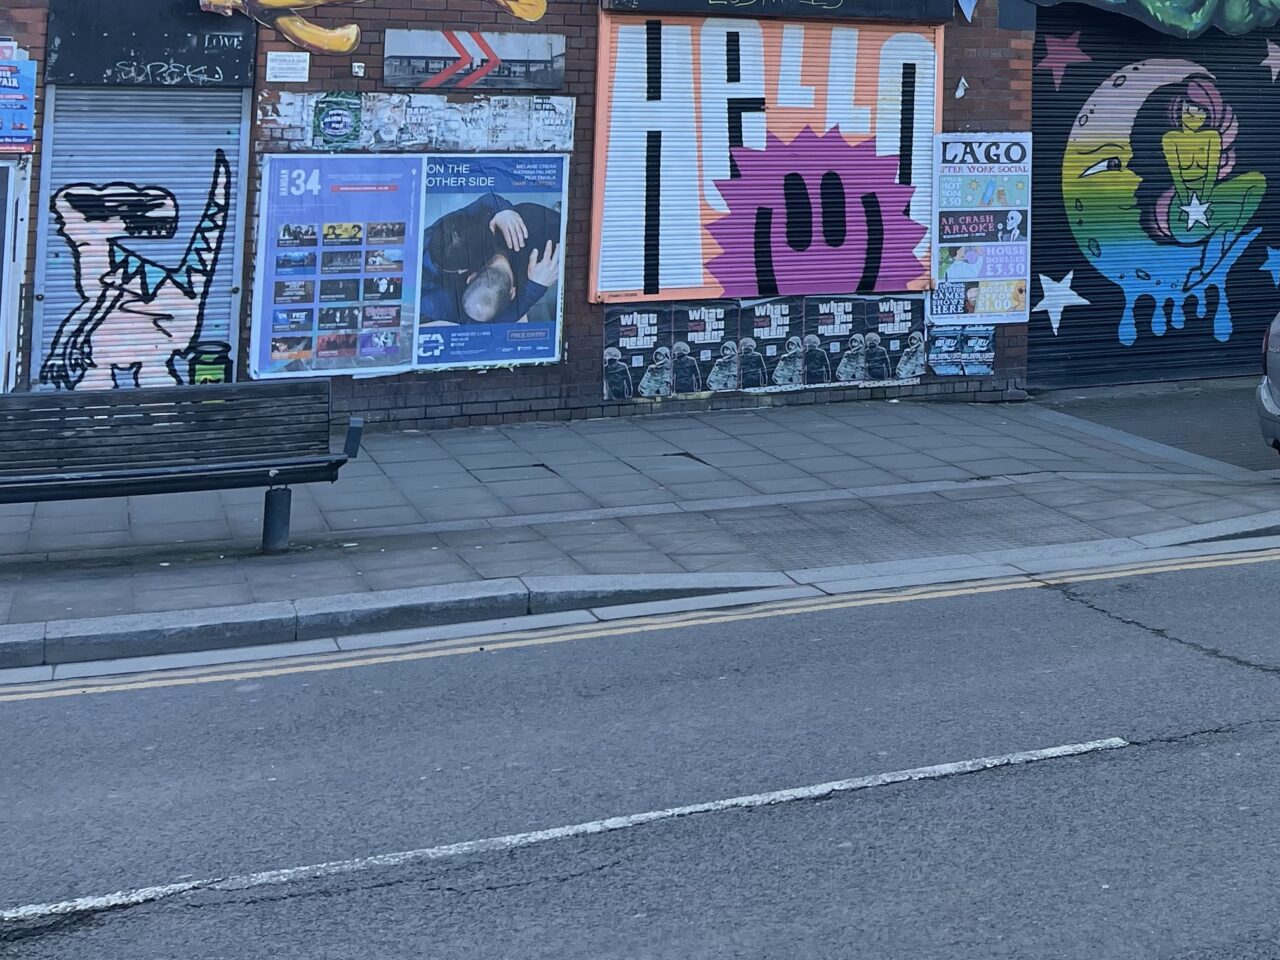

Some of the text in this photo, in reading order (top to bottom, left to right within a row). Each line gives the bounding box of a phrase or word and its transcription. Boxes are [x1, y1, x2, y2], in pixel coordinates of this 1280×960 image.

[427, 164, 470, 174] ON THE
[290, 169, 321, 196] 34
[426, 177, 495, 187] OTHER SIDE
[941, 215, 994, 225] AR CRASH
[944, 223, 995, 234] ARAOKE
[986, 247, 1025, 256] HOUSE
[932, 292, 965, 300] GAMES
[754, 303, 790, 318] what
[818, 301, 853, 315] what
[878, 299, 912, 314] what
[932, 305, 964, 314] HERE
[620, 312, 658, 326] what
[688, 307, 725, 322] what
[834, 314, 853, 325] you
[894, 312, 912, 324] you
[705, 320, 725, 332] you
[770, 316, 790, 327] you
[637, 325, 658, 337] you
